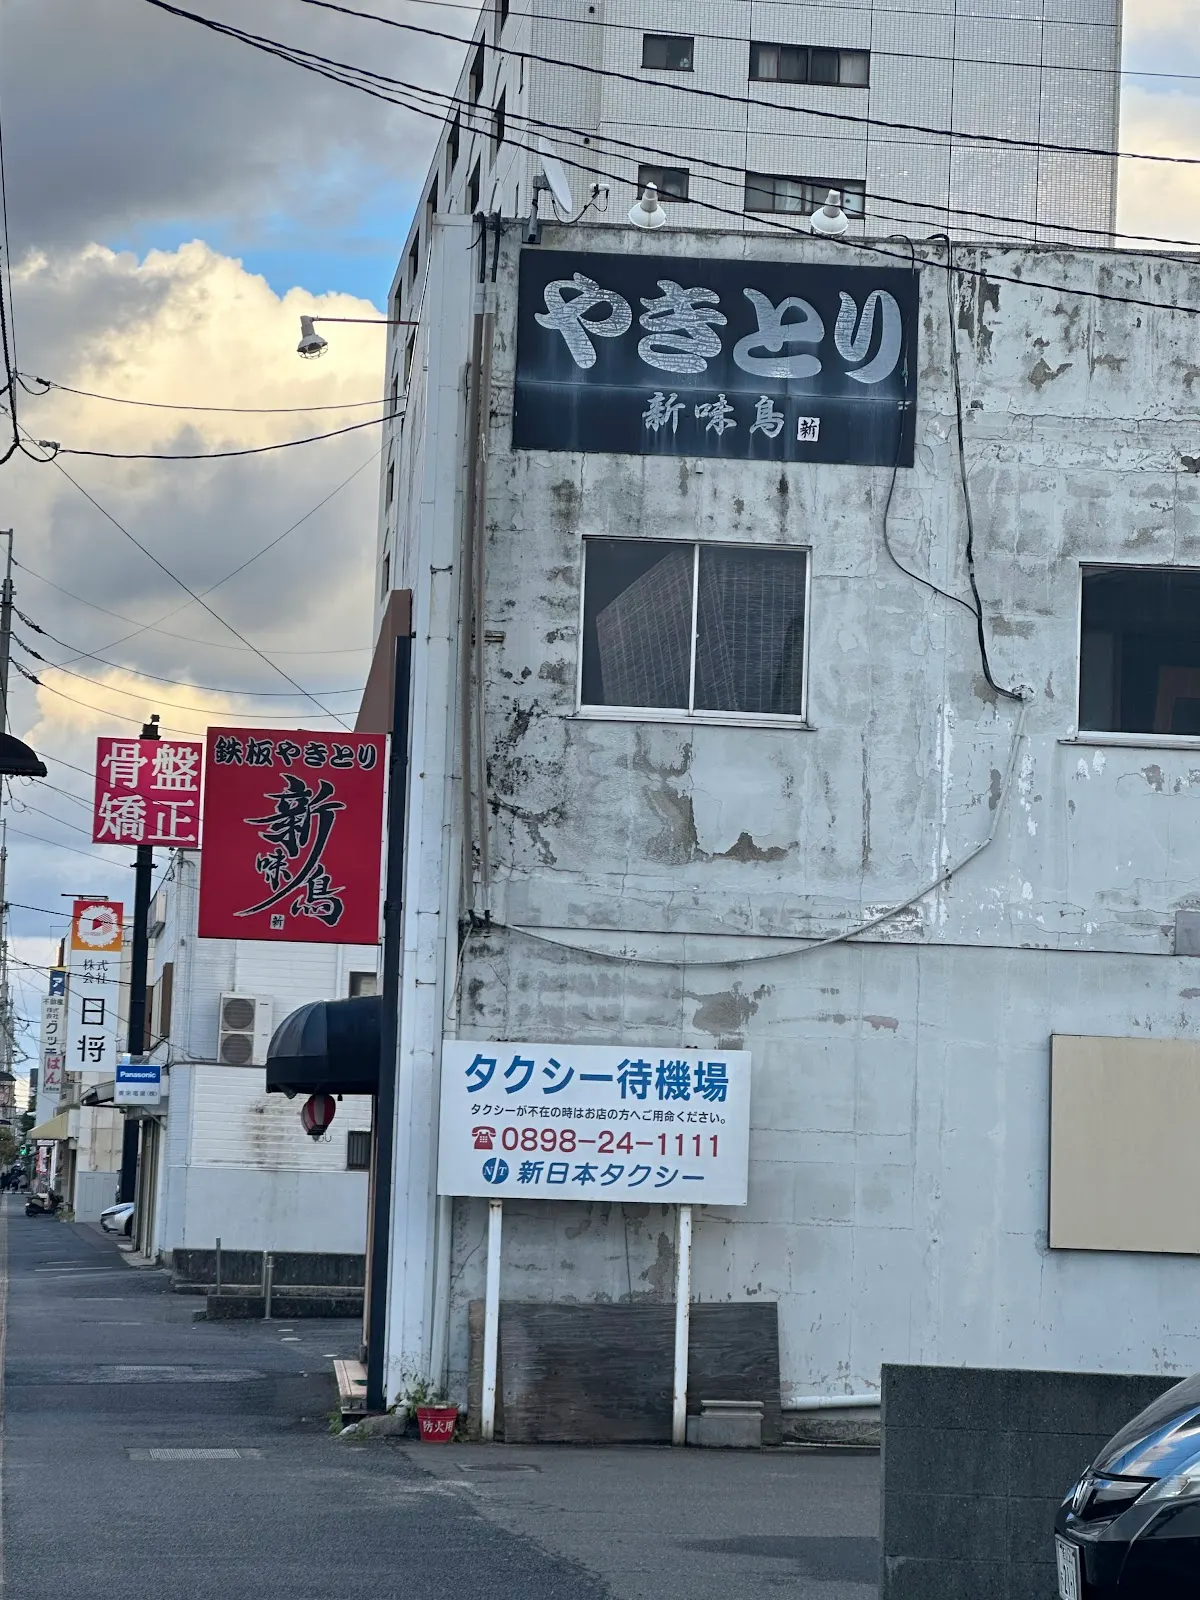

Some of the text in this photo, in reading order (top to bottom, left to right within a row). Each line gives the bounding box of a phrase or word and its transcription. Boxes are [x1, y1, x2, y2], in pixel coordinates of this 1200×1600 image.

[534, 271, 902, 384] やきとり
[642, 391, 785, 439] 新味鳥
[799, 418, 818, 440] 新
[101, 742, 199, 791] 骨盤
[214, 735, 378, 771] 鉄板やきとり
[97, 792, 196, 842] 矯正
[77, 998, 106, 1063] 日将
[119, 1071, 157, 1079] Panasonic
[465, 1053, 729, 1103] タクシー待機場
[471, 1103, 726, 1125] タクシーが不在の時はお店の方へご用命ください。
[501, 1126, 719, 1158] 0898-24-1111
[516, 1160, 705, 1188] 新日本タクシー
[423, 1420, 454, 1433] 防火用
